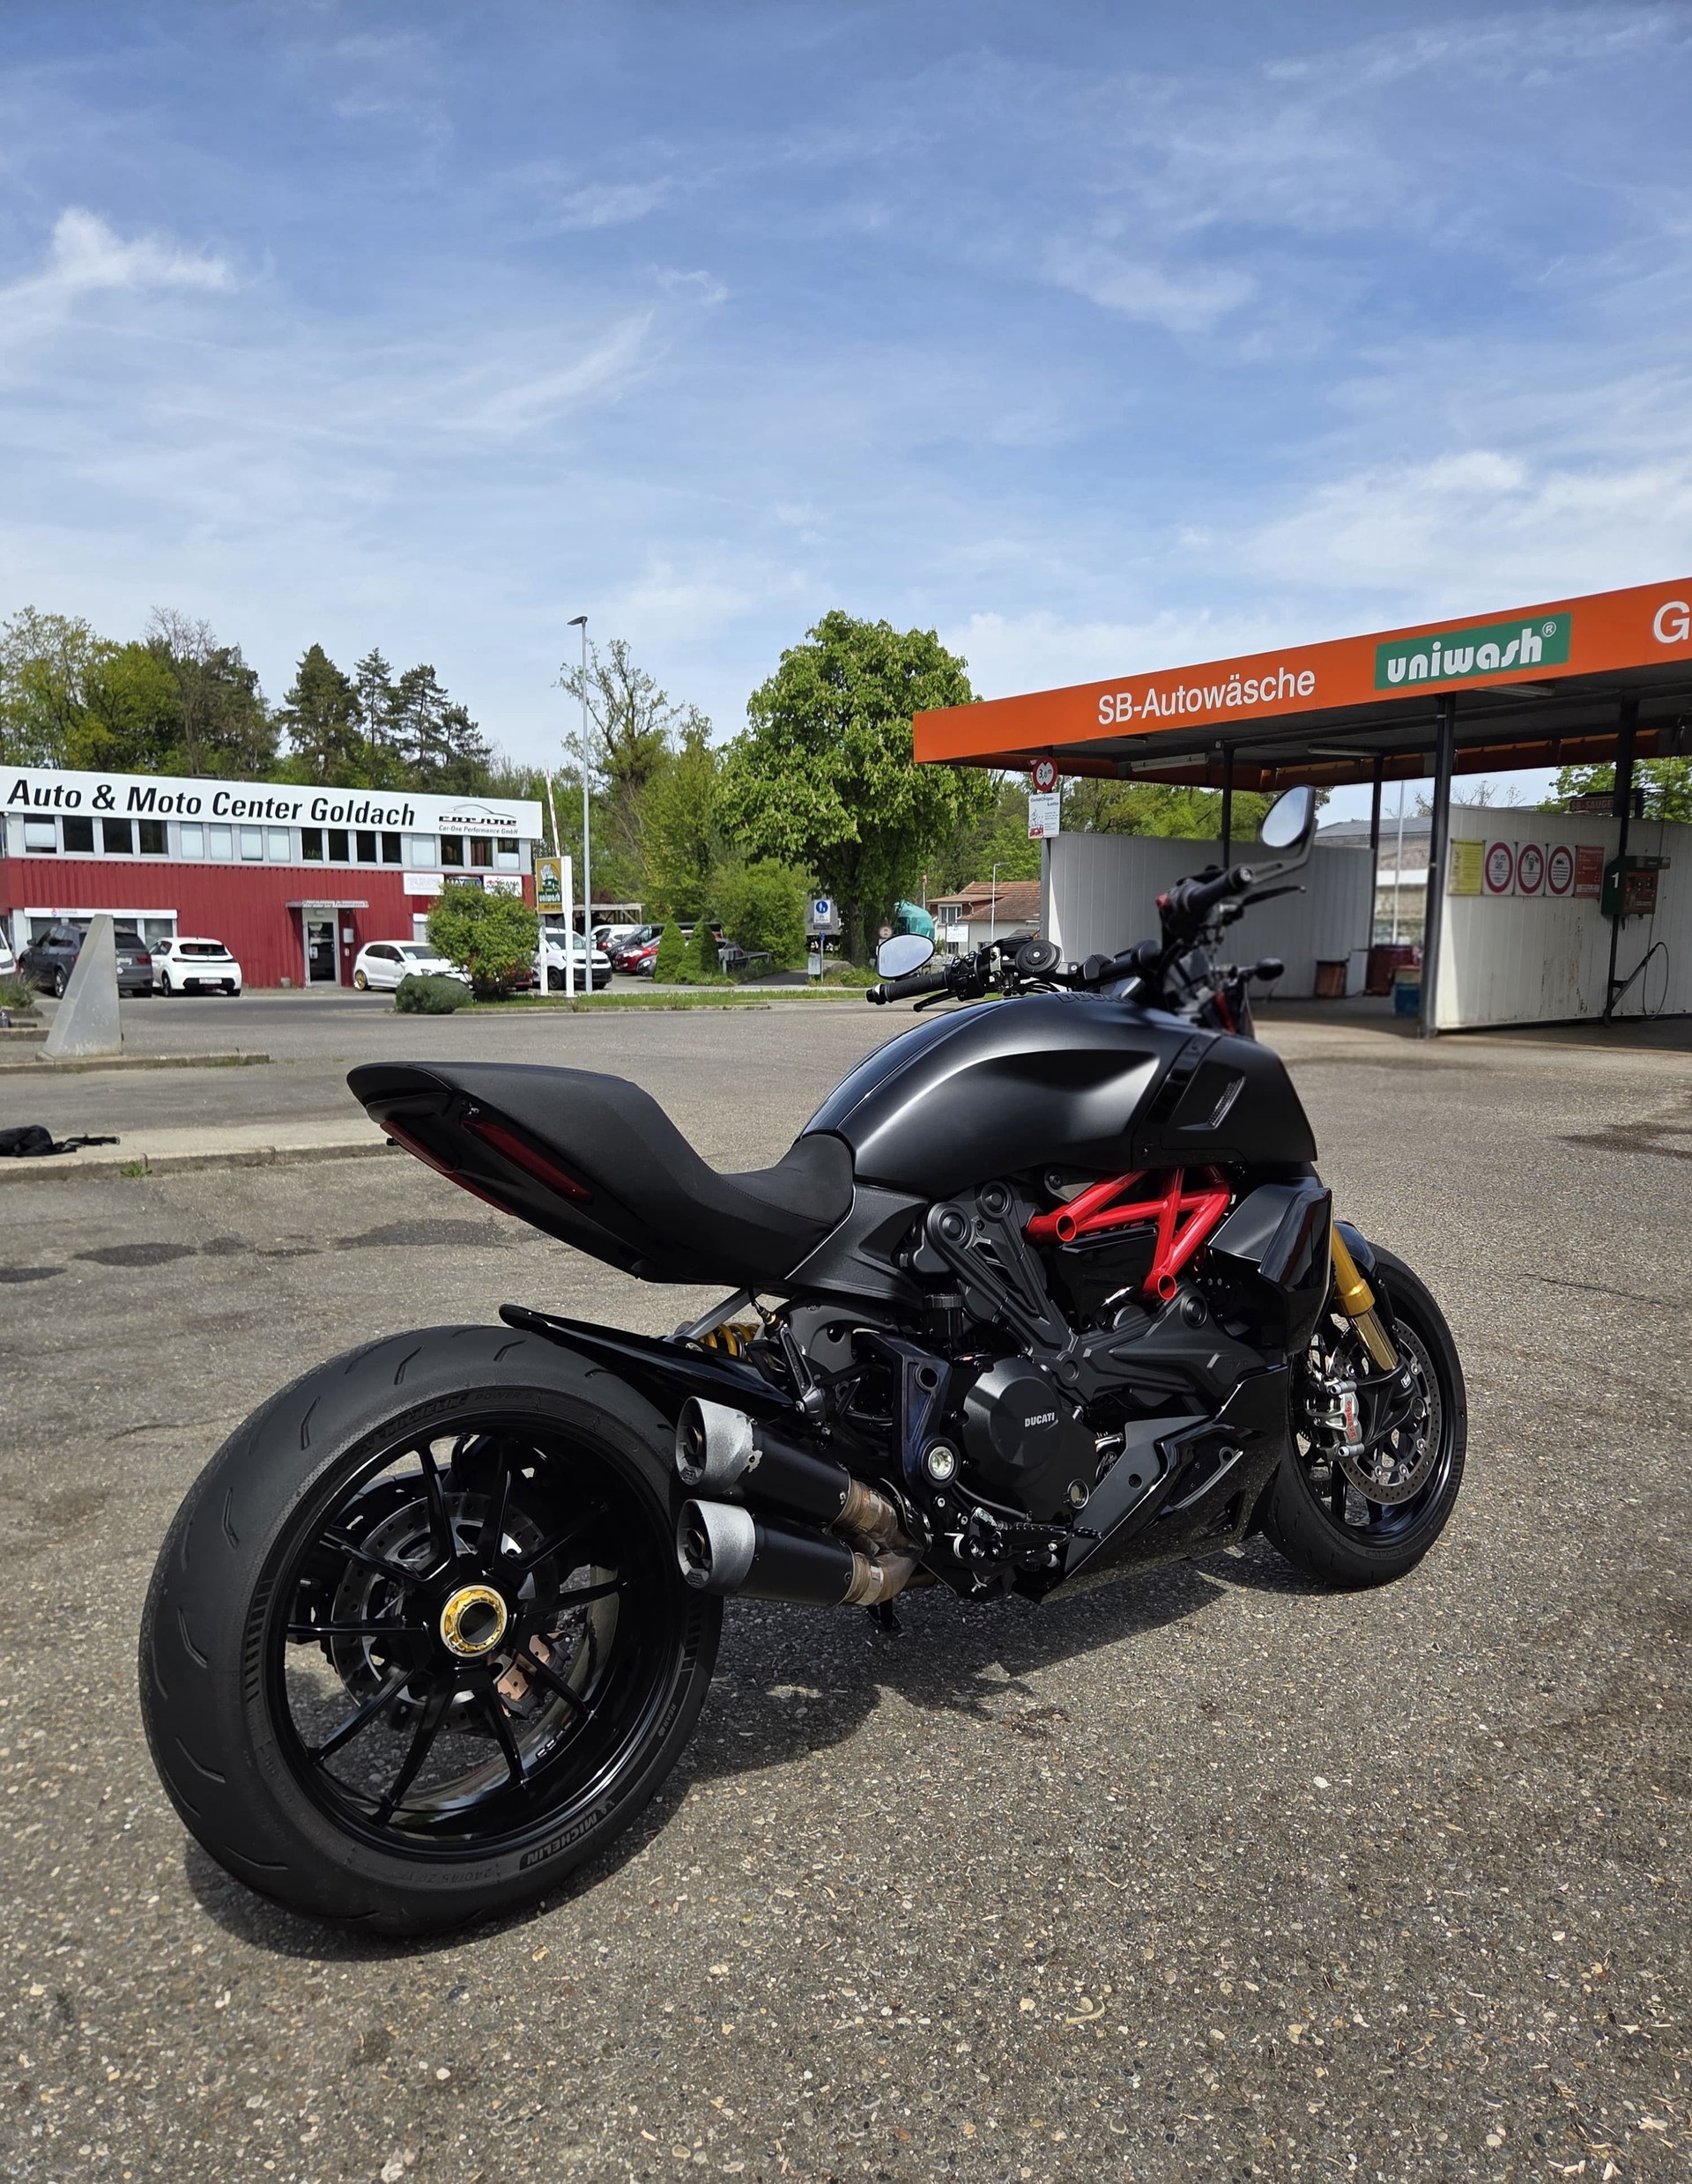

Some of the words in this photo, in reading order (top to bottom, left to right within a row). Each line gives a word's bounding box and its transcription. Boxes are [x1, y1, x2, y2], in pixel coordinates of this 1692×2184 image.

[1098, 667, 1315, 724] SB-Autowäsche
[7, 779, 82, 808] Auto
[92, 784, 115, 811] &
[127, 787, 202, 814] Moto
[212, 791, 303, 820] Center
[310, 797, 415, 826] Goldach
[1612, 872, 1619, 888] 1
[1024, 1412, 1055, 1427] DUCATI
[664, 1703, 677, 1728] REAR
[526, 1813, 597, 1865] MICHELIN
